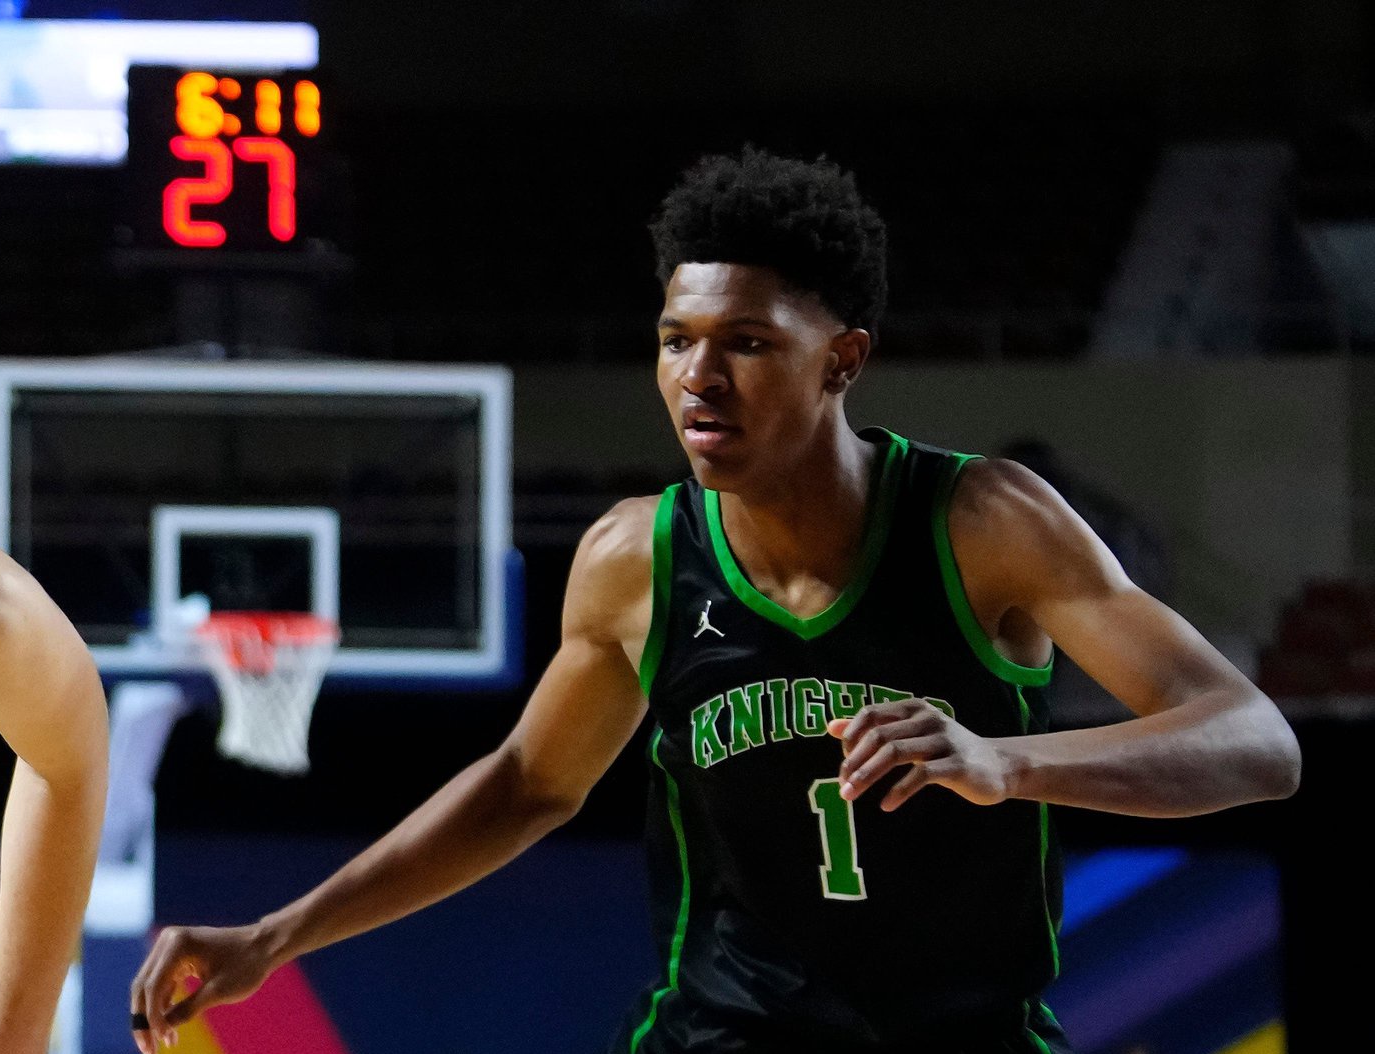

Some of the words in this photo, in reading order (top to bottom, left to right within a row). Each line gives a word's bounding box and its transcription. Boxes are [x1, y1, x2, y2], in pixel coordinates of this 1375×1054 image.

[175, 70, 322, 138] 6:11
[162, 136, 296, 248] 27
[808, 777, 868, 901] 1
